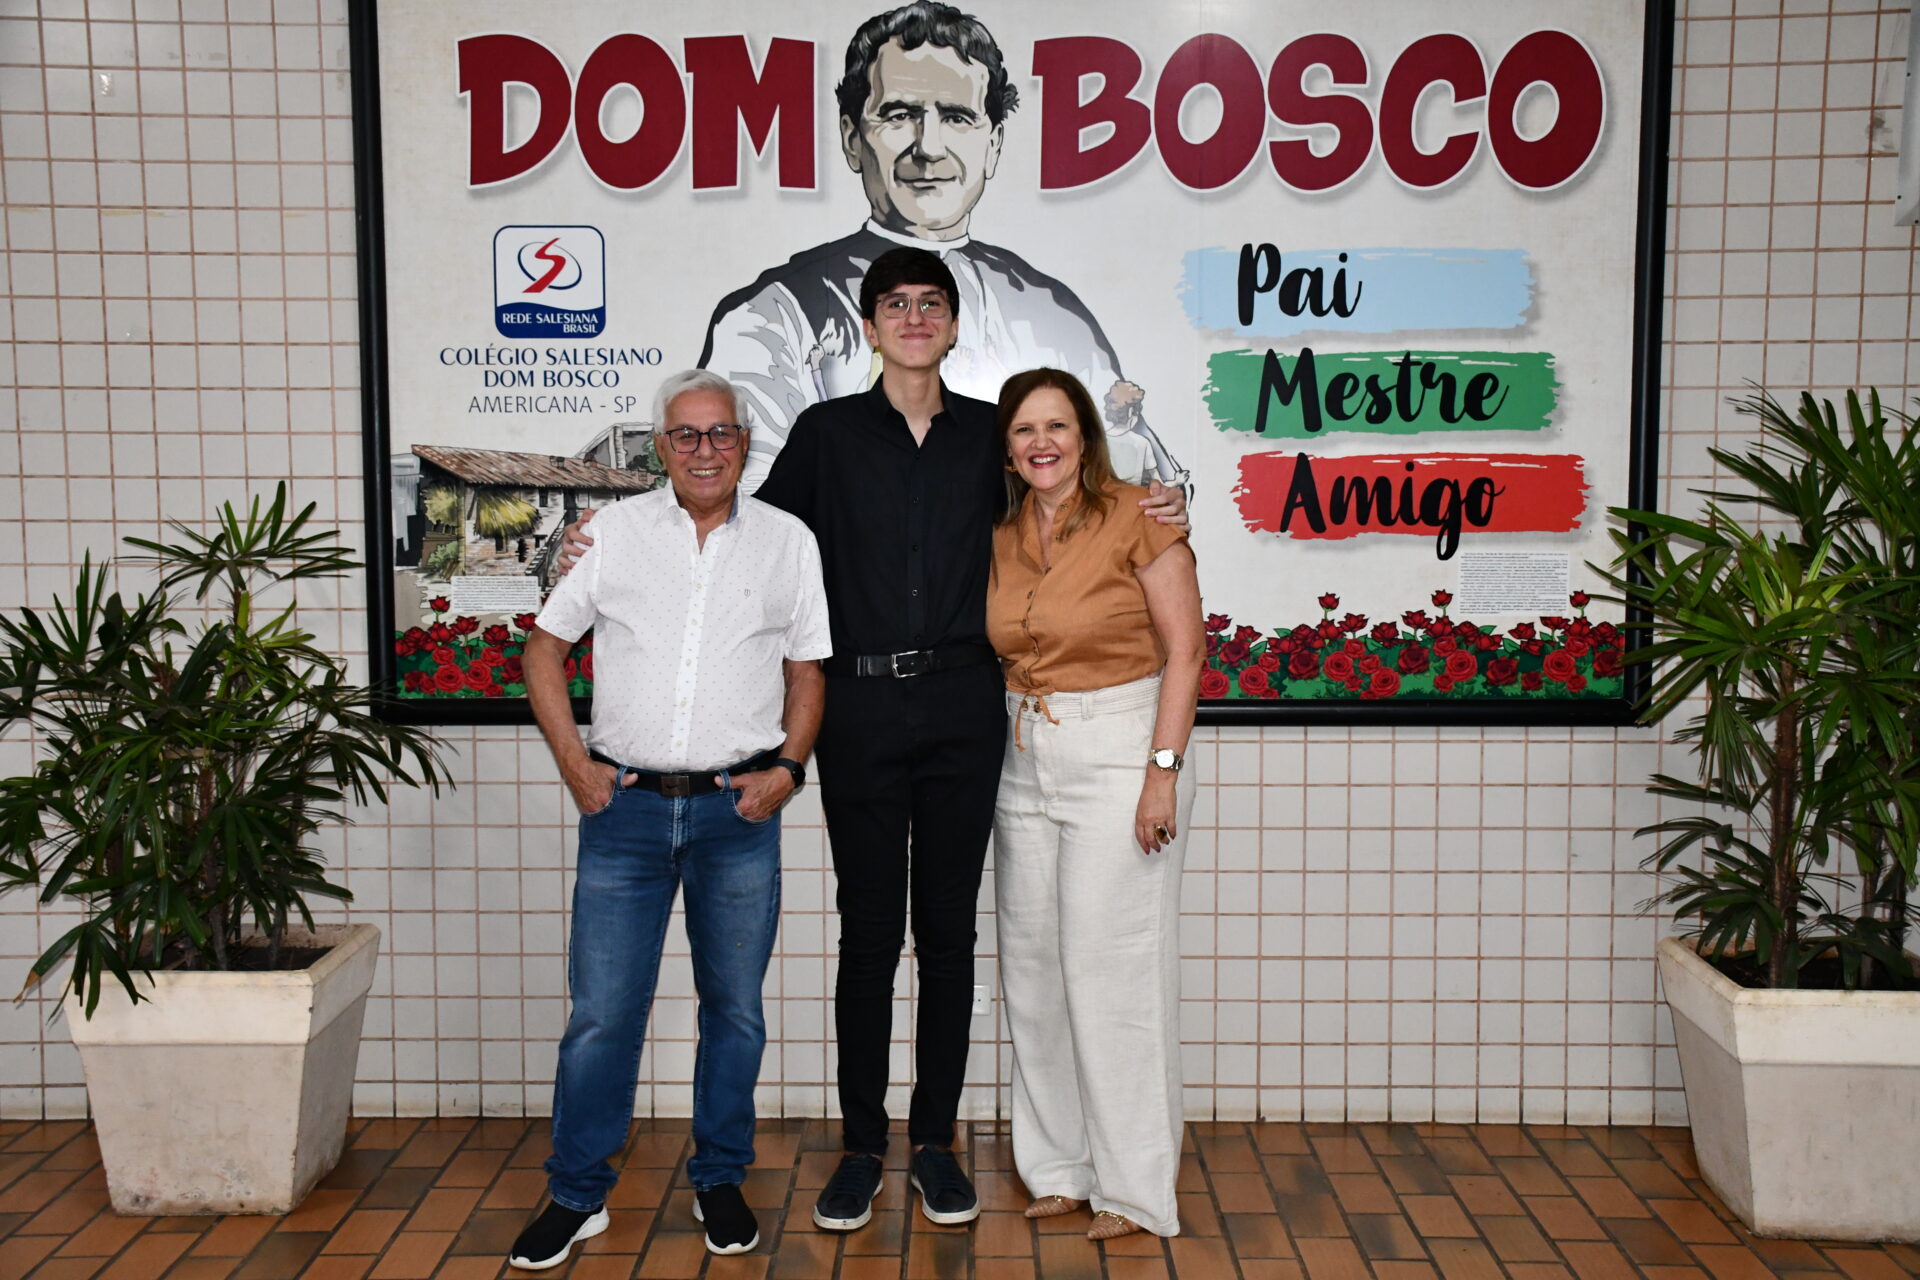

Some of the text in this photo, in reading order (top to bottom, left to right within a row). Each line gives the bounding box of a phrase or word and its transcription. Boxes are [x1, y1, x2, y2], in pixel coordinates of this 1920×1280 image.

[457, 30, 1603, 192] DOM BOSCO
[1237, 243, 1363, 327] Pai
[502, 312, 599, 324] REDE SALESIANA
[563, 323, 598, 333] BRASIL
[439, 342, 663, 366] COLÉGIO SALESIANO
[484, 369, 620, 388] DOM BOSCO
[1254, 347, 1510, 433] Mestre
[468, 395, 593, 413] AMERICANA
[613, 395, 637, 413] SP
[1279, 452, 1506, 561] Amigo
